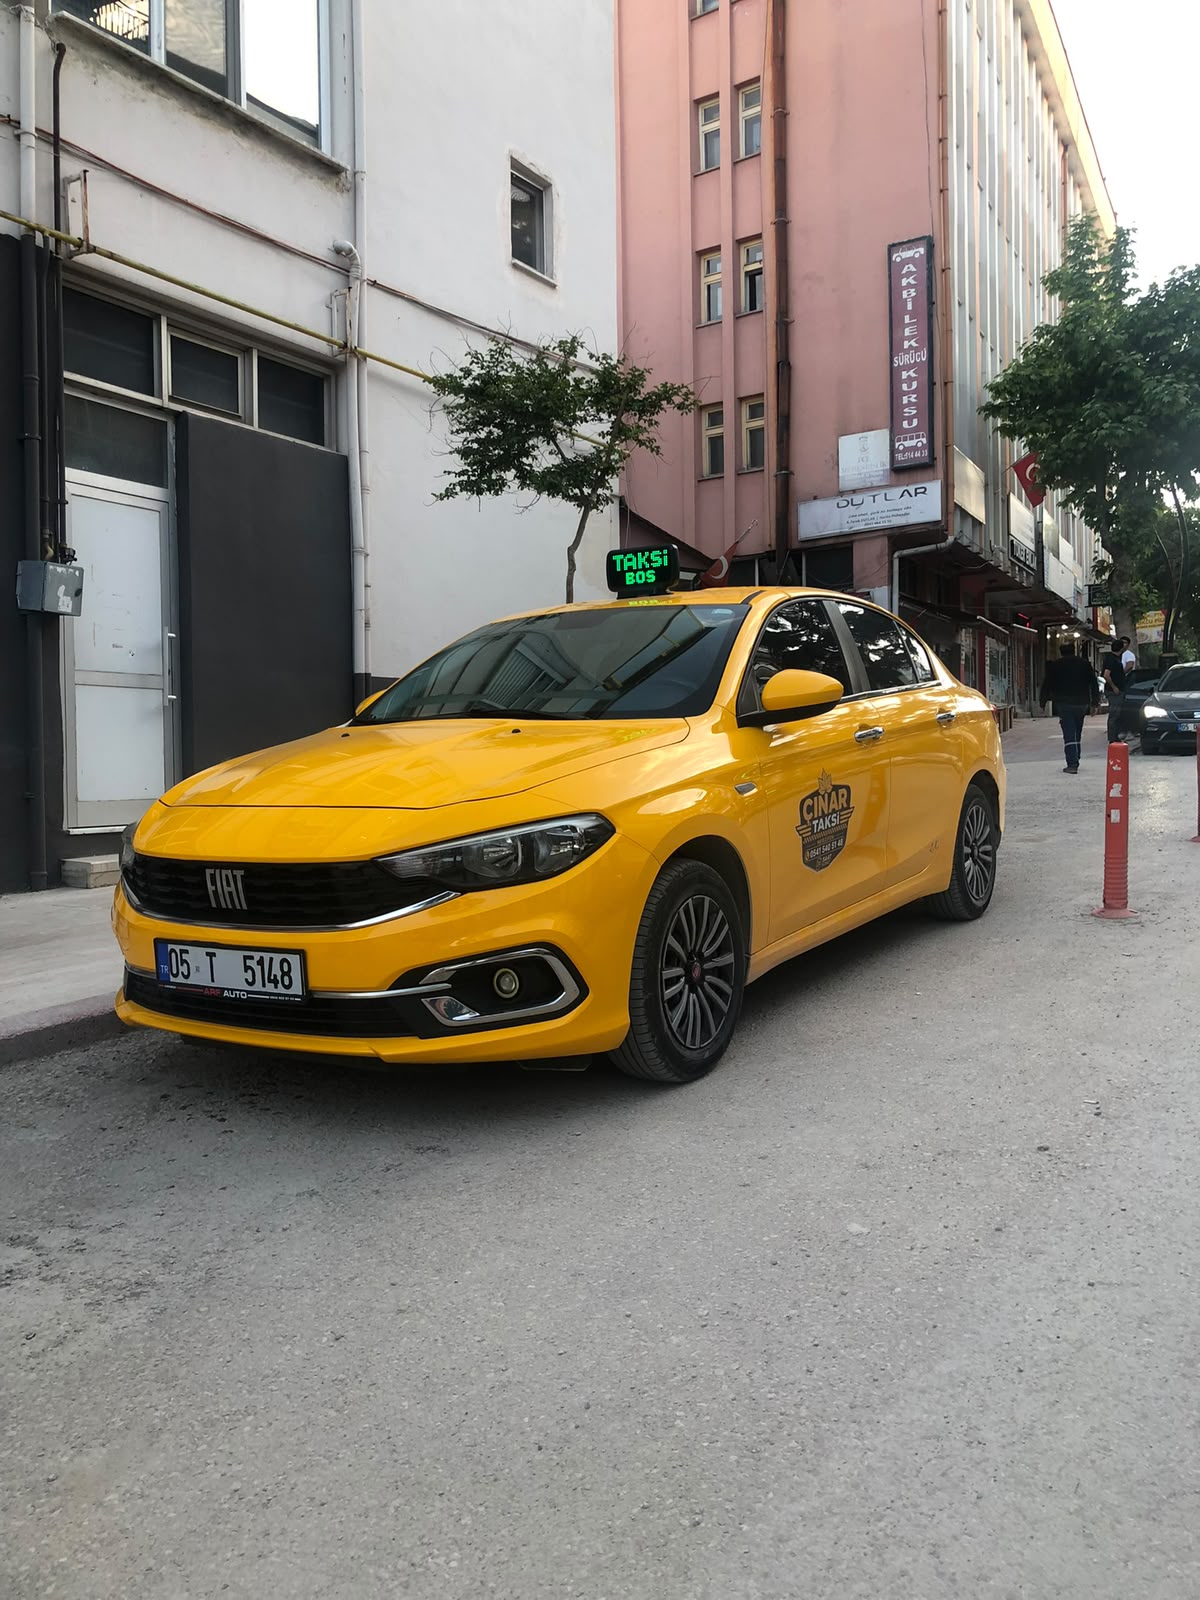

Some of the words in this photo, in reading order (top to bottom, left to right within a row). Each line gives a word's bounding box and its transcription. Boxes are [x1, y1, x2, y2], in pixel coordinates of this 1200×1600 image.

[901, 366, 919, 428] KURSU
[836, 486, 928, 509] DUTLAR
[803, 788, 848, 825] ÇINAR
[205, 868, 248, 910] FIAT
[160, 964, 169, 974] TR
[169, 947, 191, 980] 05
[205, 951, 217, 983] T
[243, 954, 293, 990] 5148
[223, 989, 248, 999] AUTO
